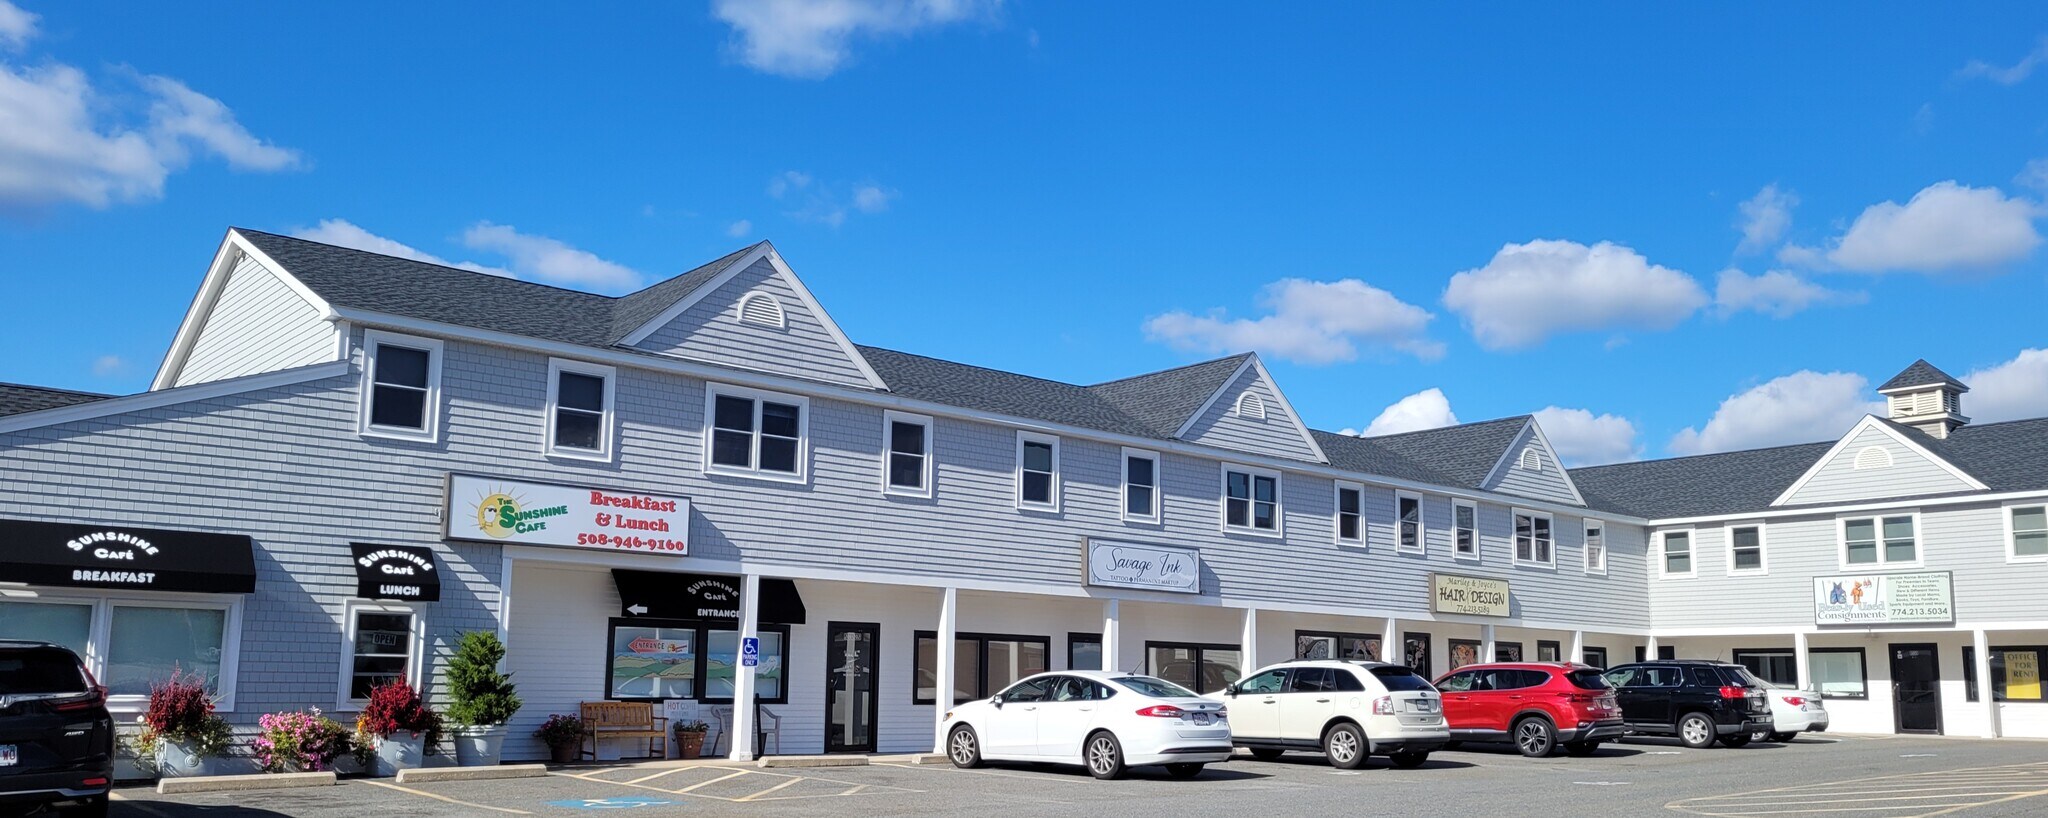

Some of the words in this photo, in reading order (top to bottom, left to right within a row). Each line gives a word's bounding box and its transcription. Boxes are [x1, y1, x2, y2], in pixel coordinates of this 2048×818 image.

[590, 491, 676, 513] Breakfast
[595, 512, 612, 527] &
[615, 514, 669, 532] Lunch
[67, 531, 159, 555] SUNSHINE
[577, 533, 684, 551] 508-946-9160
[359, 550, 433, 571] SUNSHINE
[1106, 547, 1153, 578] Savage
[1159, 553, 1182, 576] Ink
[72, 569, 156, 583] BREAKFAST
[380, 585, 420, 596] LUNCH
[687, 580, 739, 597] SUNSHINE
[1440, 587, 1465, 602] HAIR
[1471, 590, 1505, 606] DESIGN
[697, 608, 740, 618] ENTRANCE
[1818, 610, 1886, 622] Consignments
[1891, 607, 1948, 615] 774.213.5034
[374, 633, 396, 645] OPEN
[635, 642, 665, 650] ENTRANCE
[2013, 670, 2034, 678] RENT
[667, 702, 680, 710] HOT
